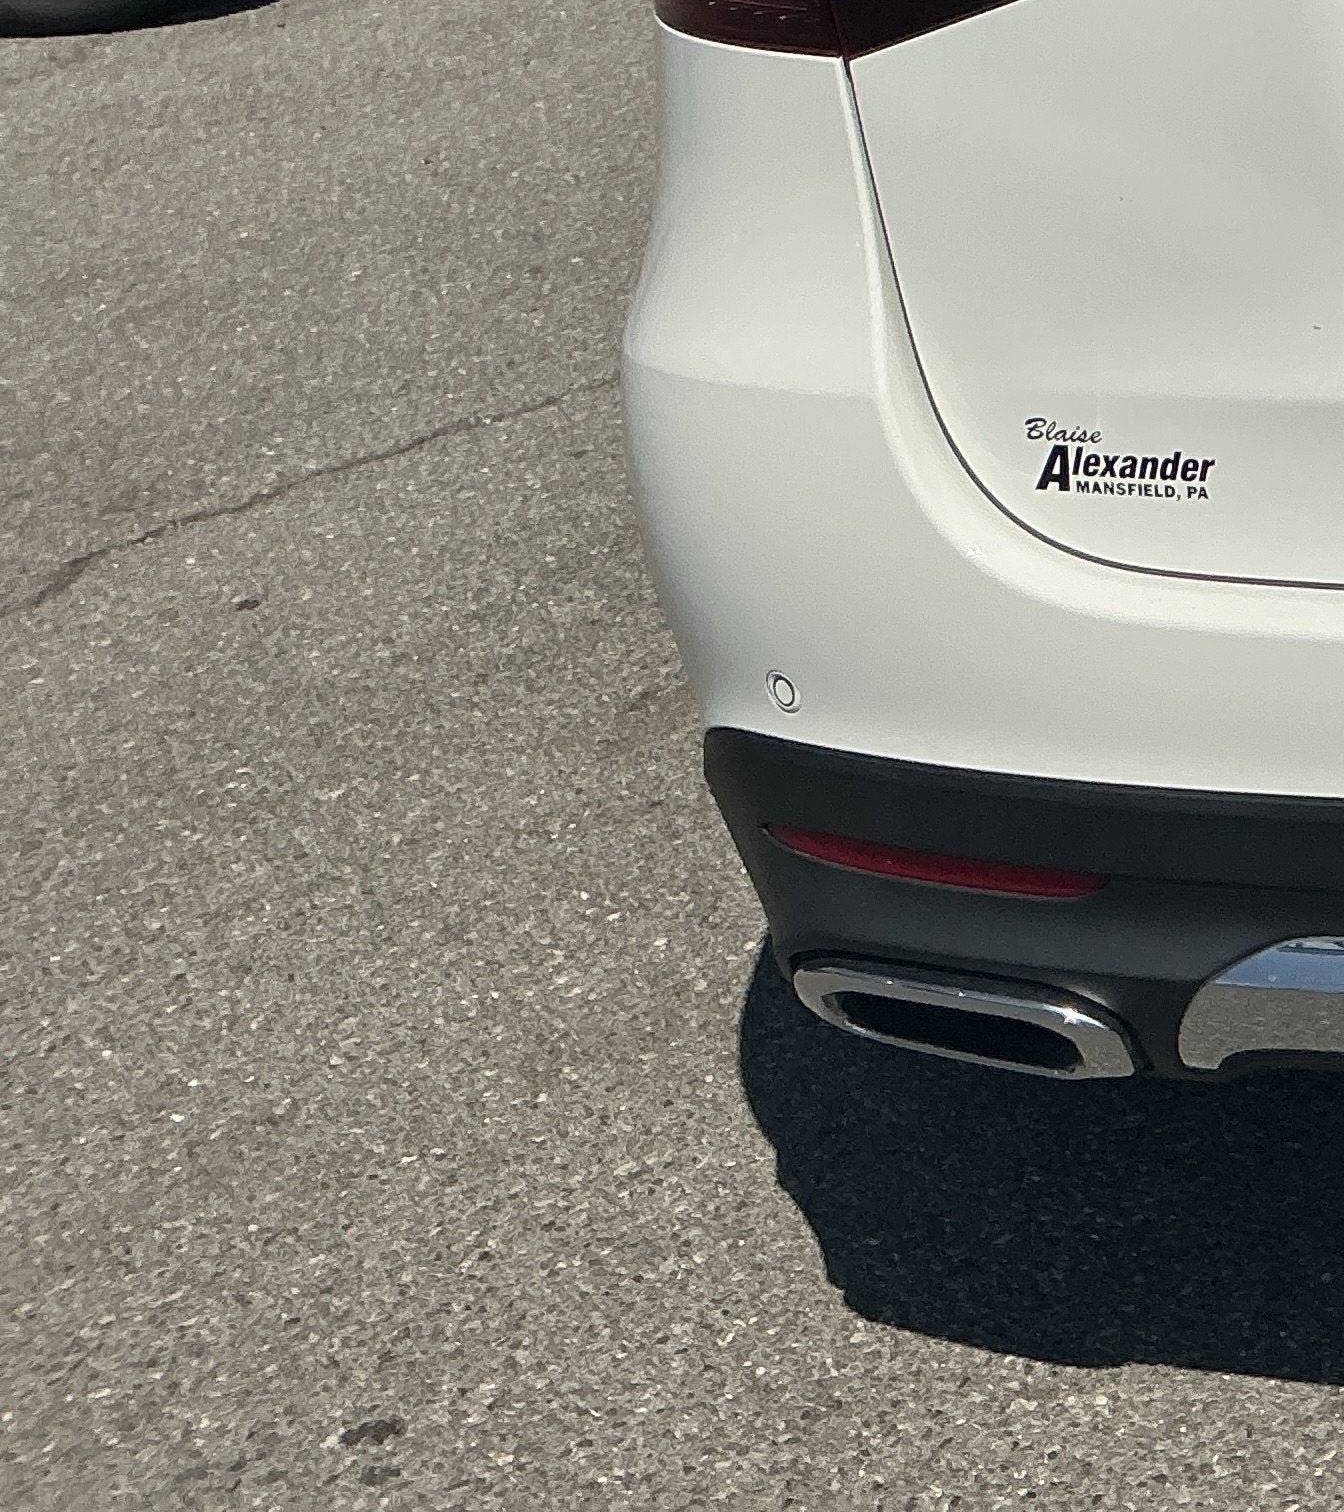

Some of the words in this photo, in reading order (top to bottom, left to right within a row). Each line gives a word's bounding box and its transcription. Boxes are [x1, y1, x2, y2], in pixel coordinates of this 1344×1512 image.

[1025, 417, 1102, 443] Blaise
[1035, 444, 1216, 491] Alexander
[1076, 480, 1181, 501] MANSFIELD,
[1187, 486, 1209, 500] PA
